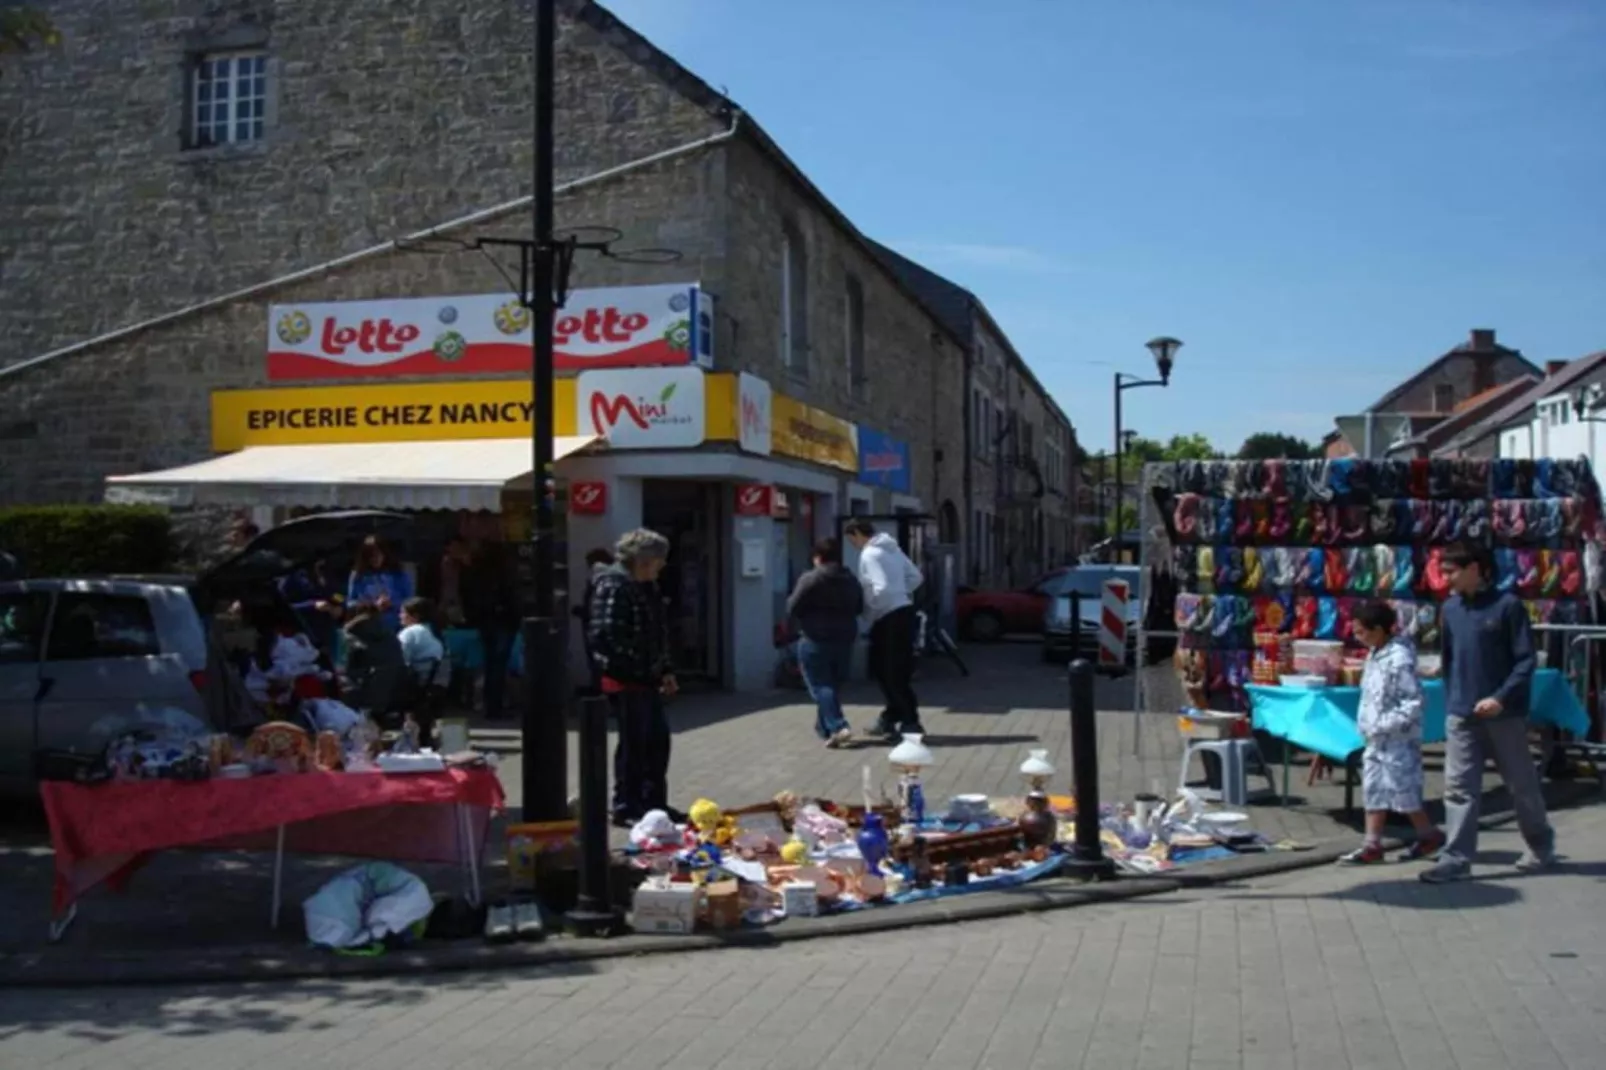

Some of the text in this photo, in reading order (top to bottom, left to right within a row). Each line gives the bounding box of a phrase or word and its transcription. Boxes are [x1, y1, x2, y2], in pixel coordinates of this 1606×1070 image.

[320, 316, 421, 355] Lotto
[553, 306, 649, 346] otto
[247, 402, 535, 430] EPICERIE CHEZ NANCY
[590, 390, 668, 436] Mini
